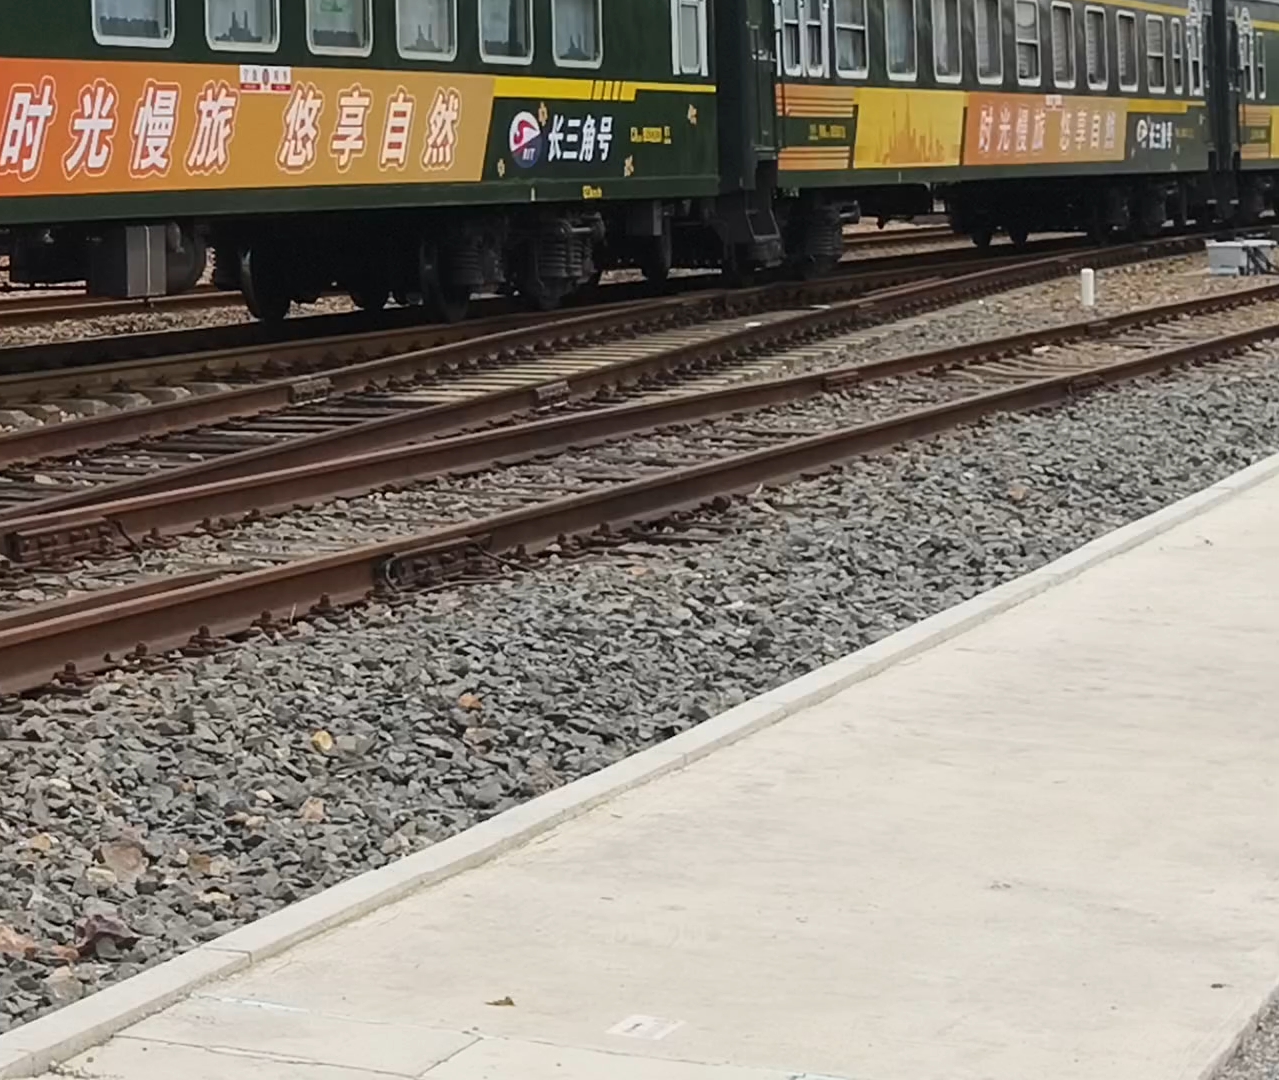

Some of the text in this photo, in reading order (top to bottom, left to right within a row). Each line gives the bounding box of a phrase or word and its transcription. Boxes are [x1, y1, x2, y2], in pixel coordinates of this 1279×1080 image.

[0, 85, 460, 173] 时光慢旅 悠享自然
[547, 113, 613, 162] 长三角号
